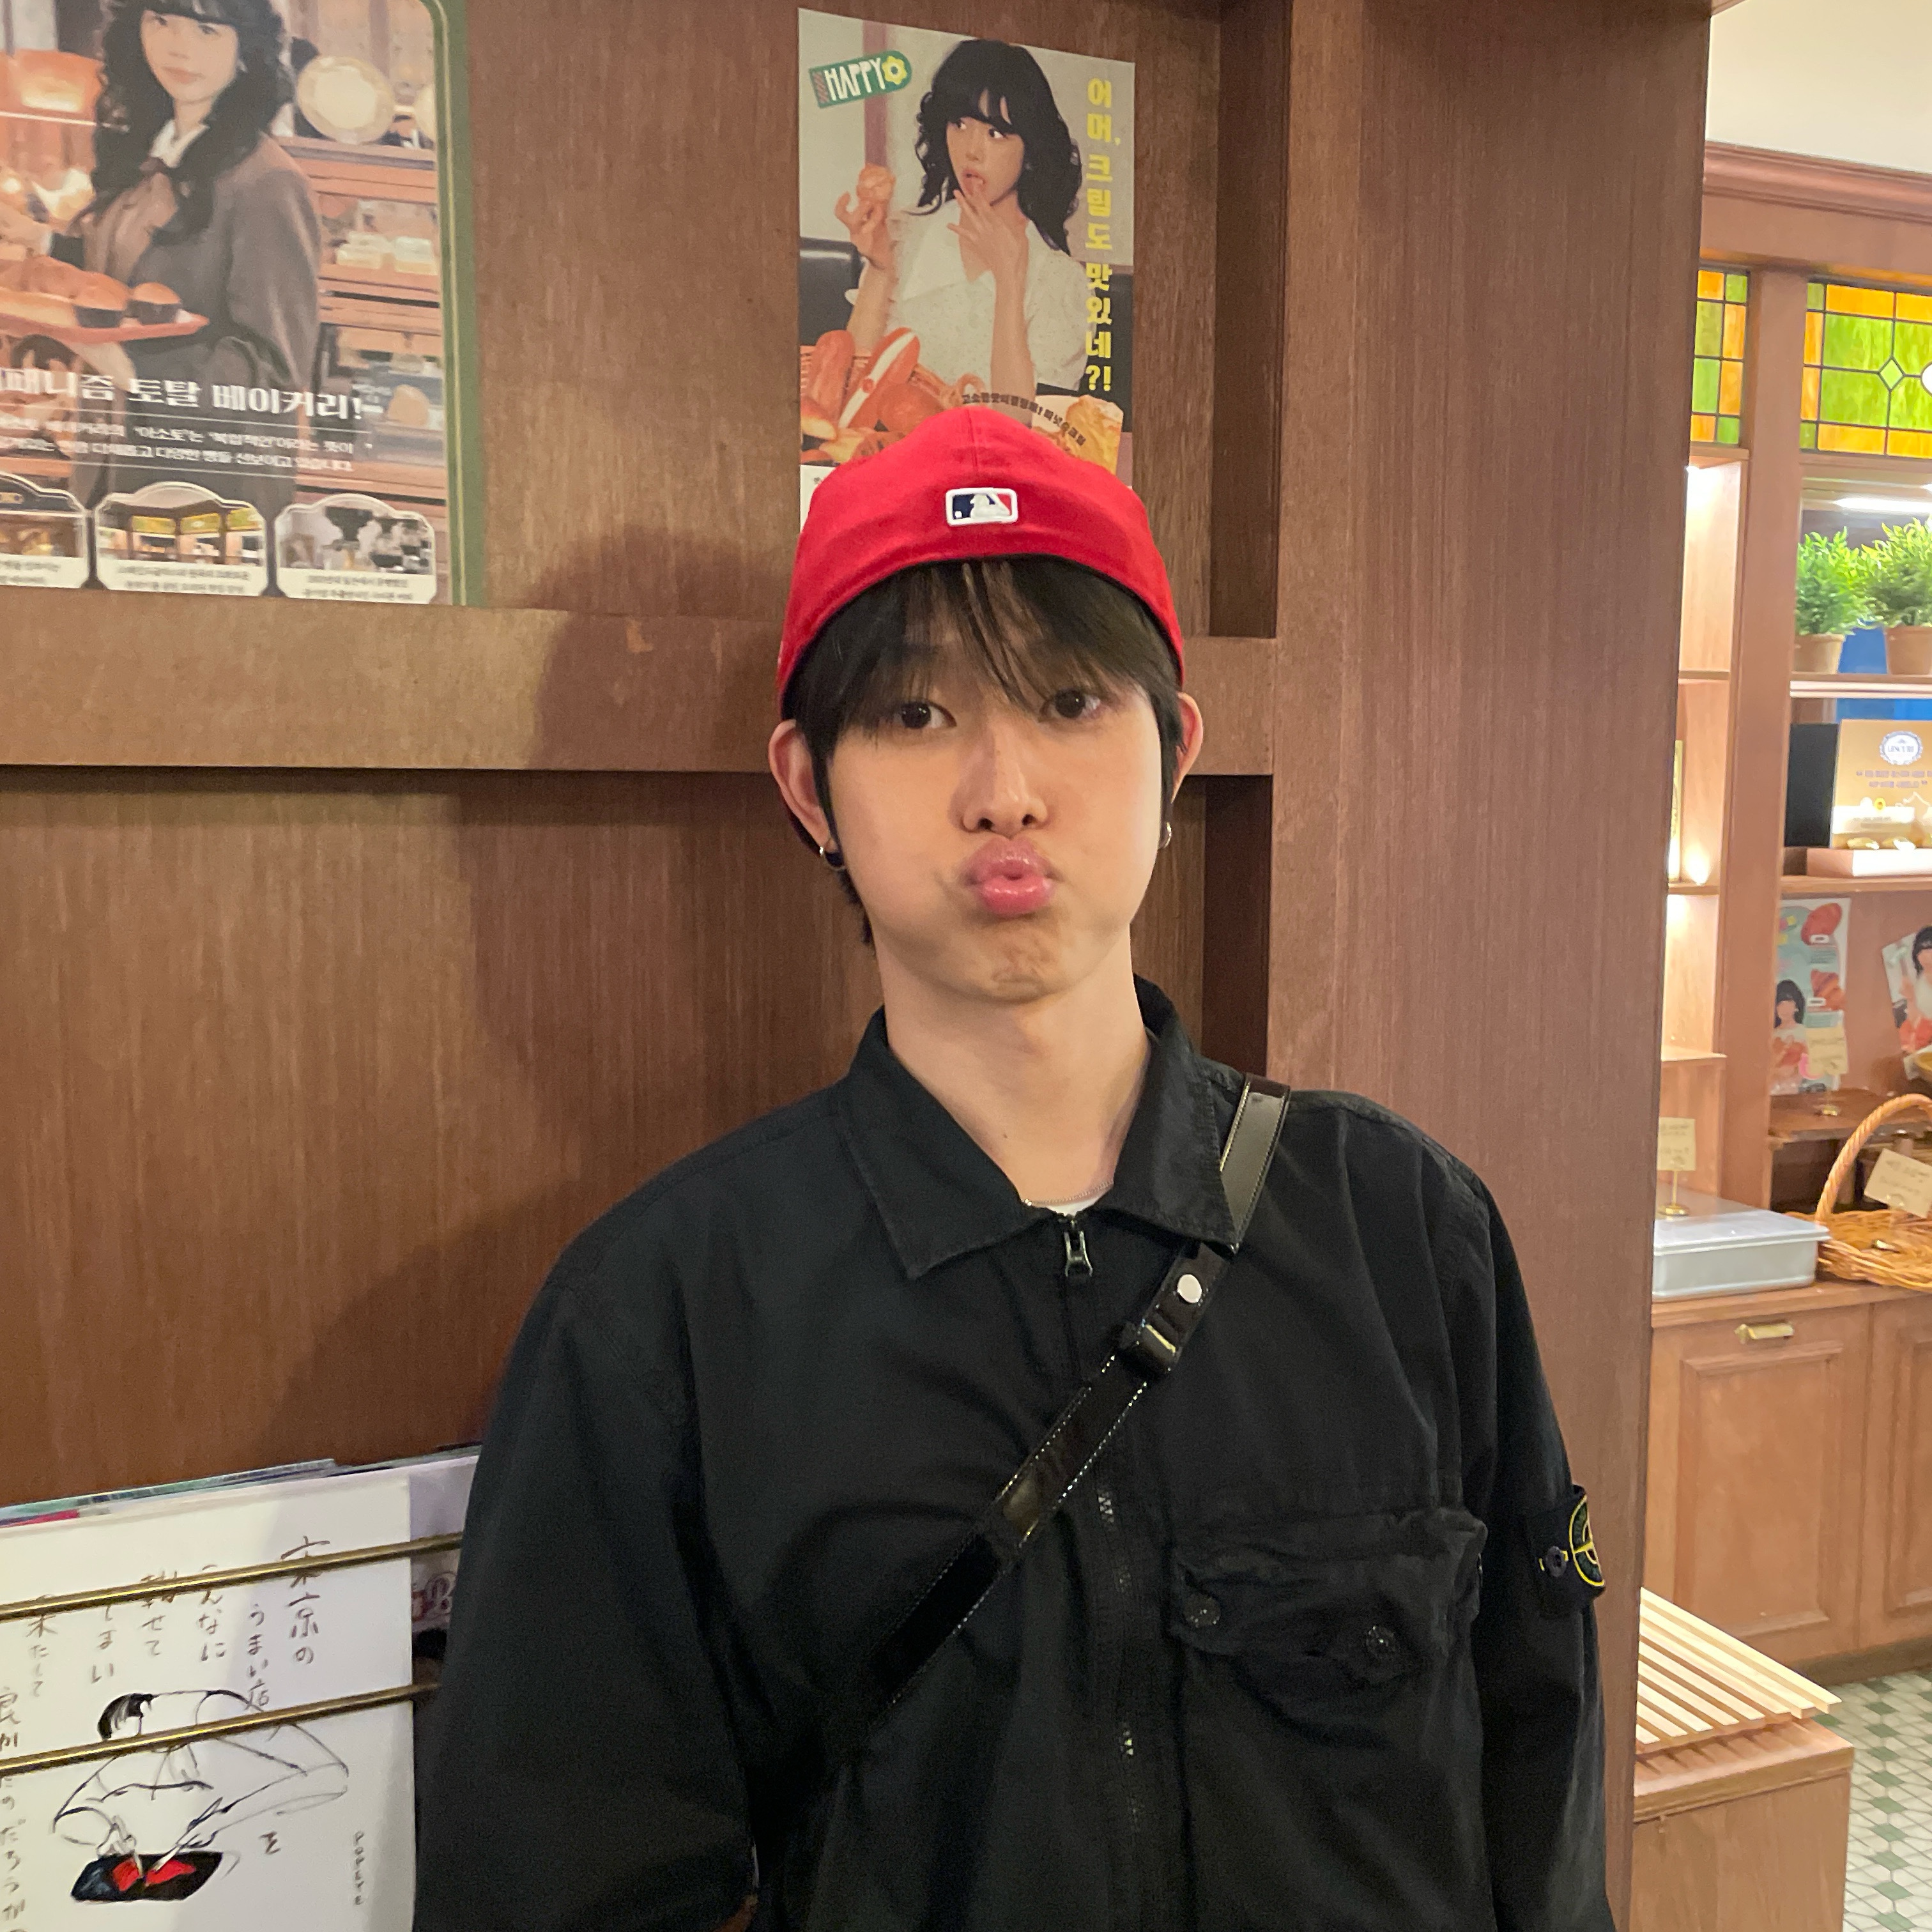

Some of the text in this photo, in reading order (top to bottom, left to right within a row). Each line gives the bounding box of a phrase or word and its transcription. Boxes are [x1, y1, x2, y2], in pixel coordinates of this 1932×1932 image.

[824, 57, 885, 102] HAPPY
[1085, 77, 1121, 392] 어머, 크림도 맛있네?!
[127, 378, 201, 408] 토탈
[213, 384, 362, 420] 베이커리!
[245, 1602, 270, 1712] うまい店
